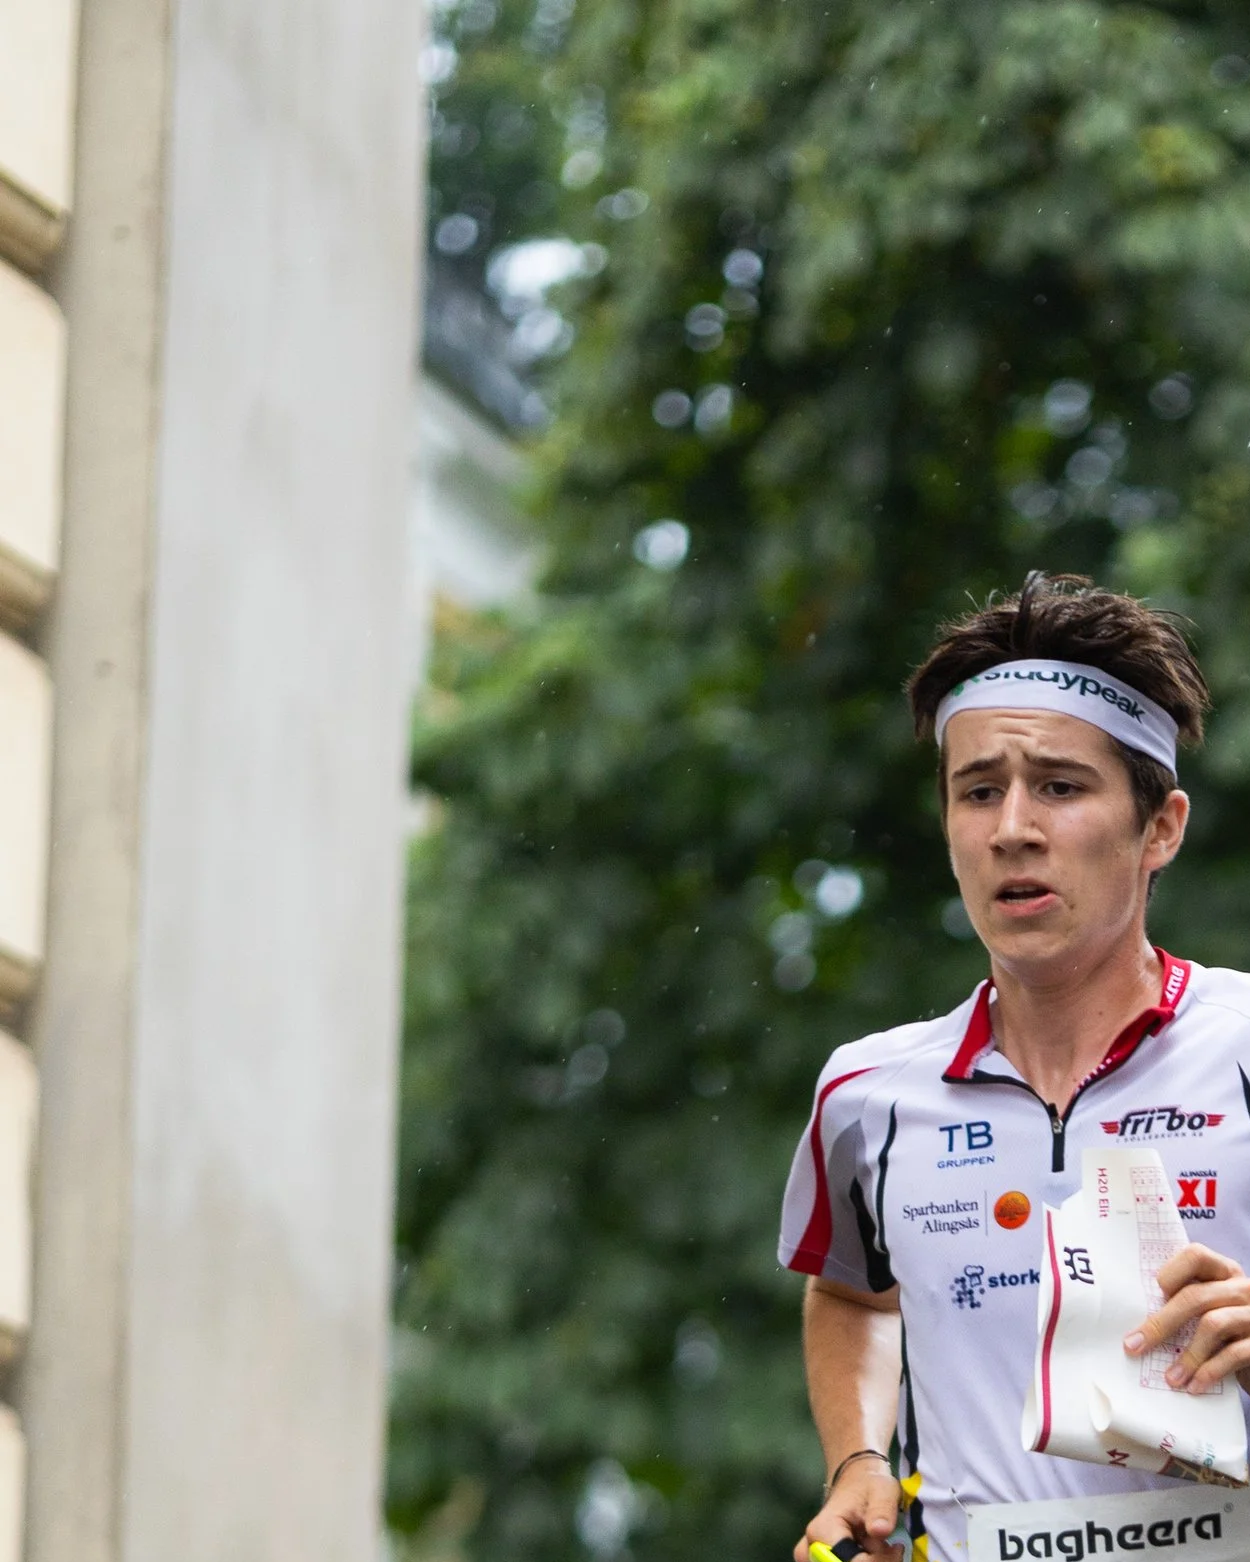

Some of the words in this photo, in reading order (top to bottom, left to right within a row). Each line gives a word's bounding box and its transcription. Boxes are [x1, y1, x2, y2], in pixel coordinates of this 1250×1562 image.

[938, 1121, 994, 1152] TB
[937, 1155, 995, 1169] GRUPPEN
[902, 1200, 979, 1221] Sparbanken
[1098, 1198, 1110, 1218] Elit
[921, 1217, 980, 1235] Alingsås
[998, 1513, 1222, 1562] bagheera
